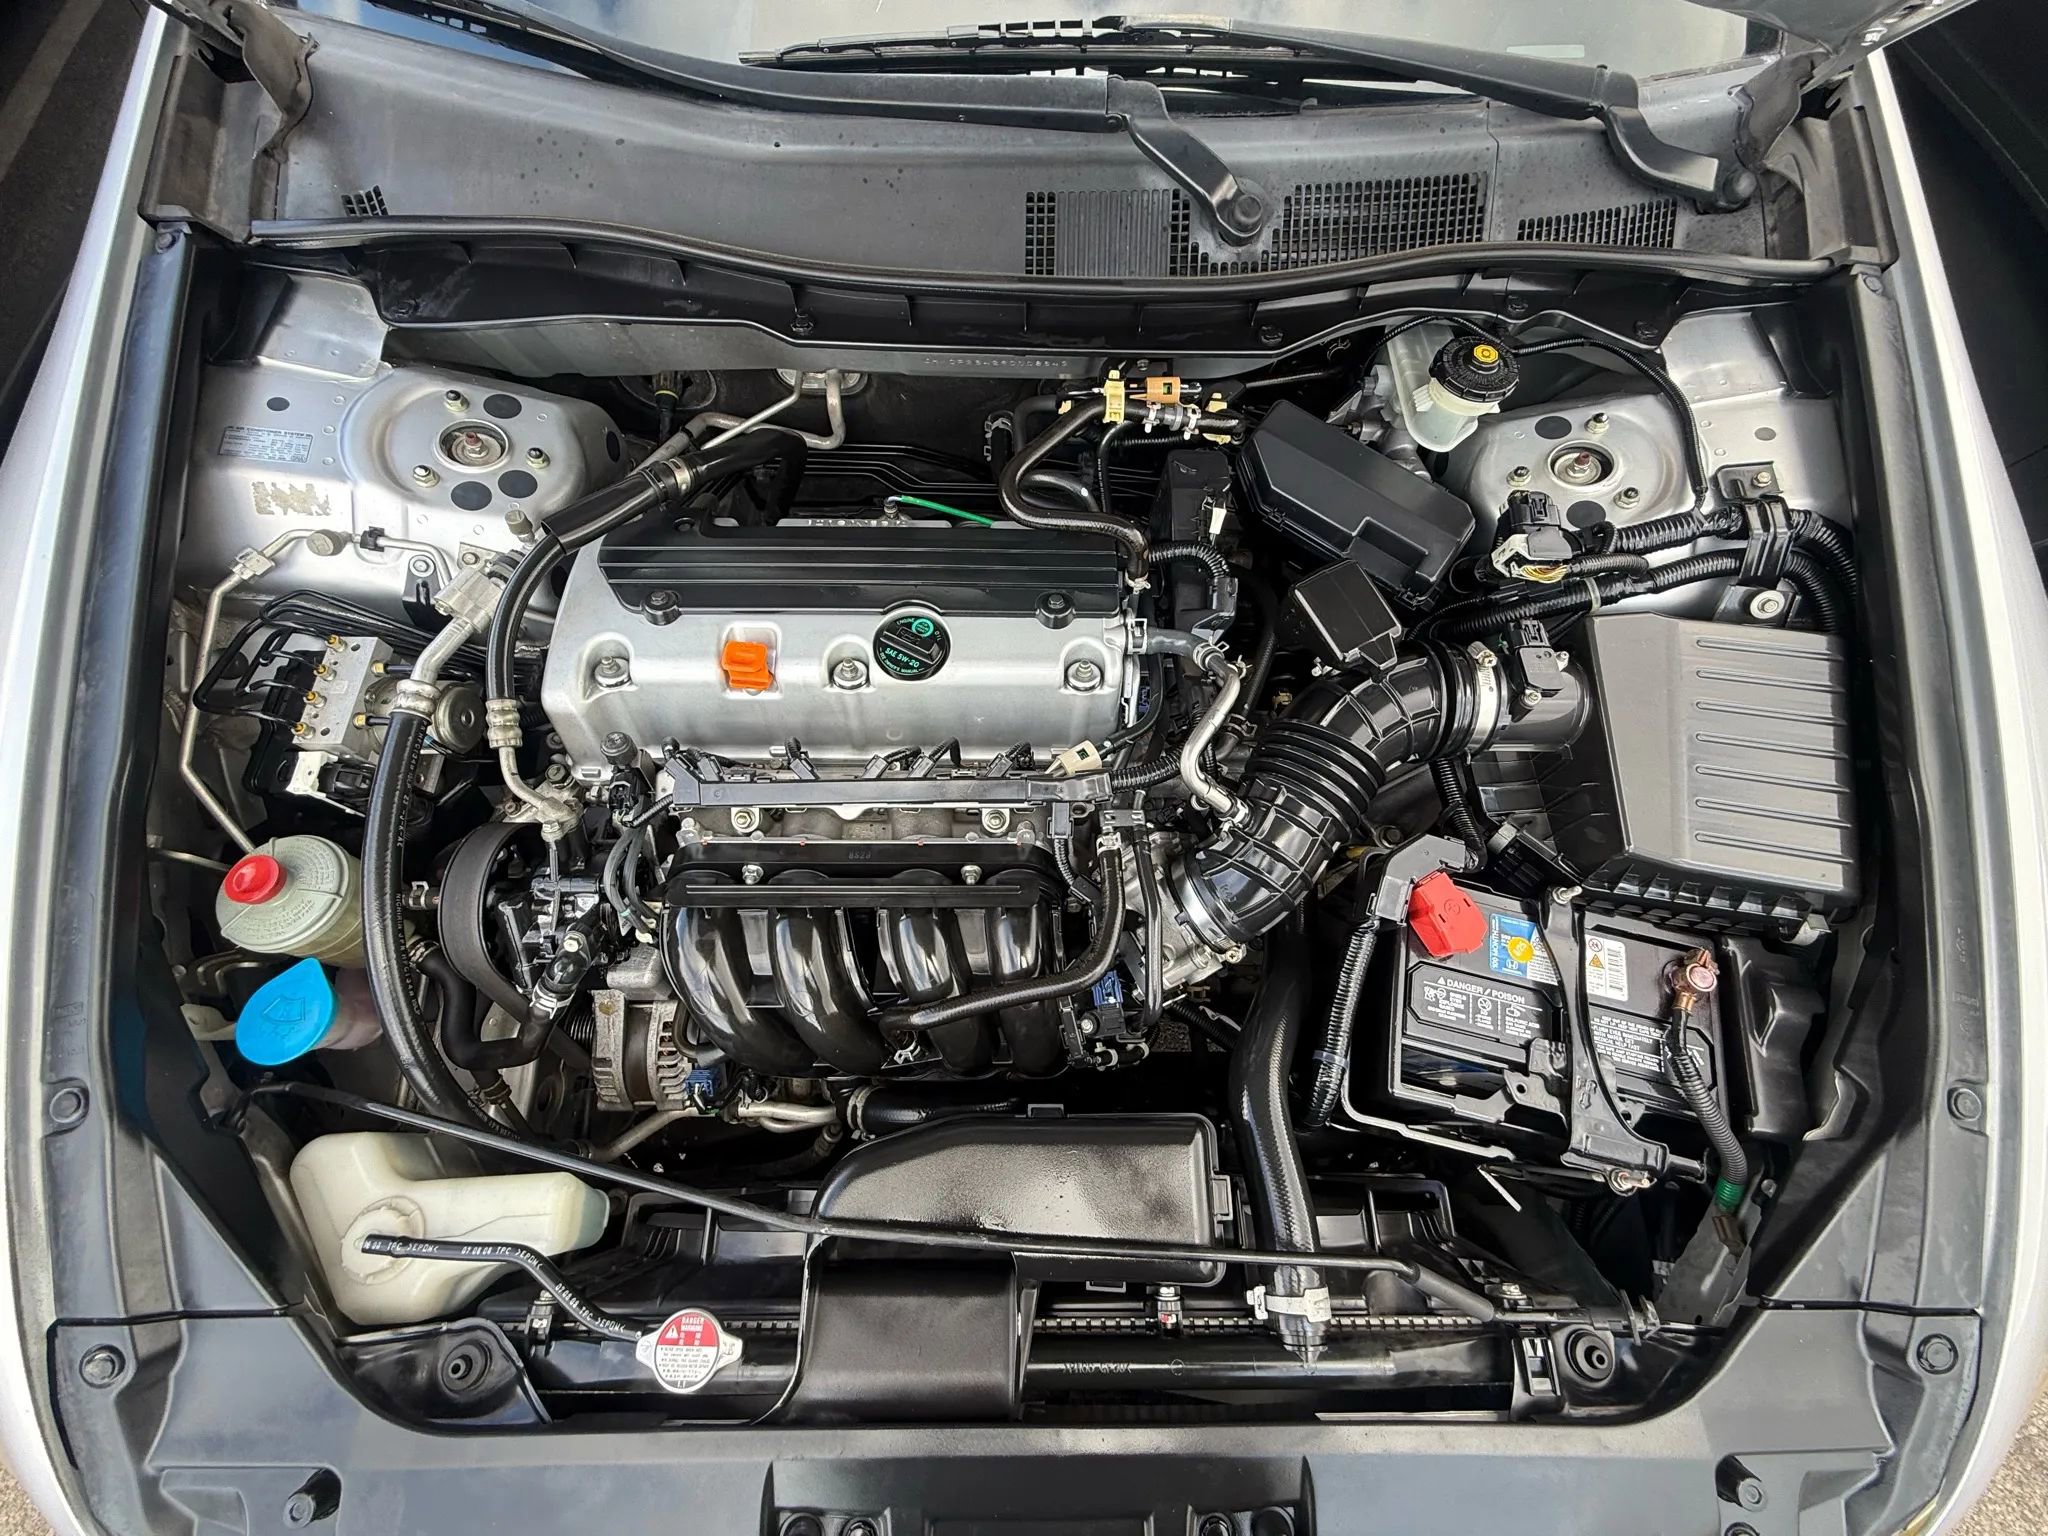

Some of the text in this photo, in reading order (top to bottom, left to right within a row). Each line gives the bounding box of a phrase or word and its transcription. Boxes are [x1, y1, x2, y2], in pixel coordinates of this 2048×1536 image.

[885, 647, 897, 659] SAE
[1447, 979, 1483, 996] DANGER
[1492, 990, 1526, 1004] POISON
